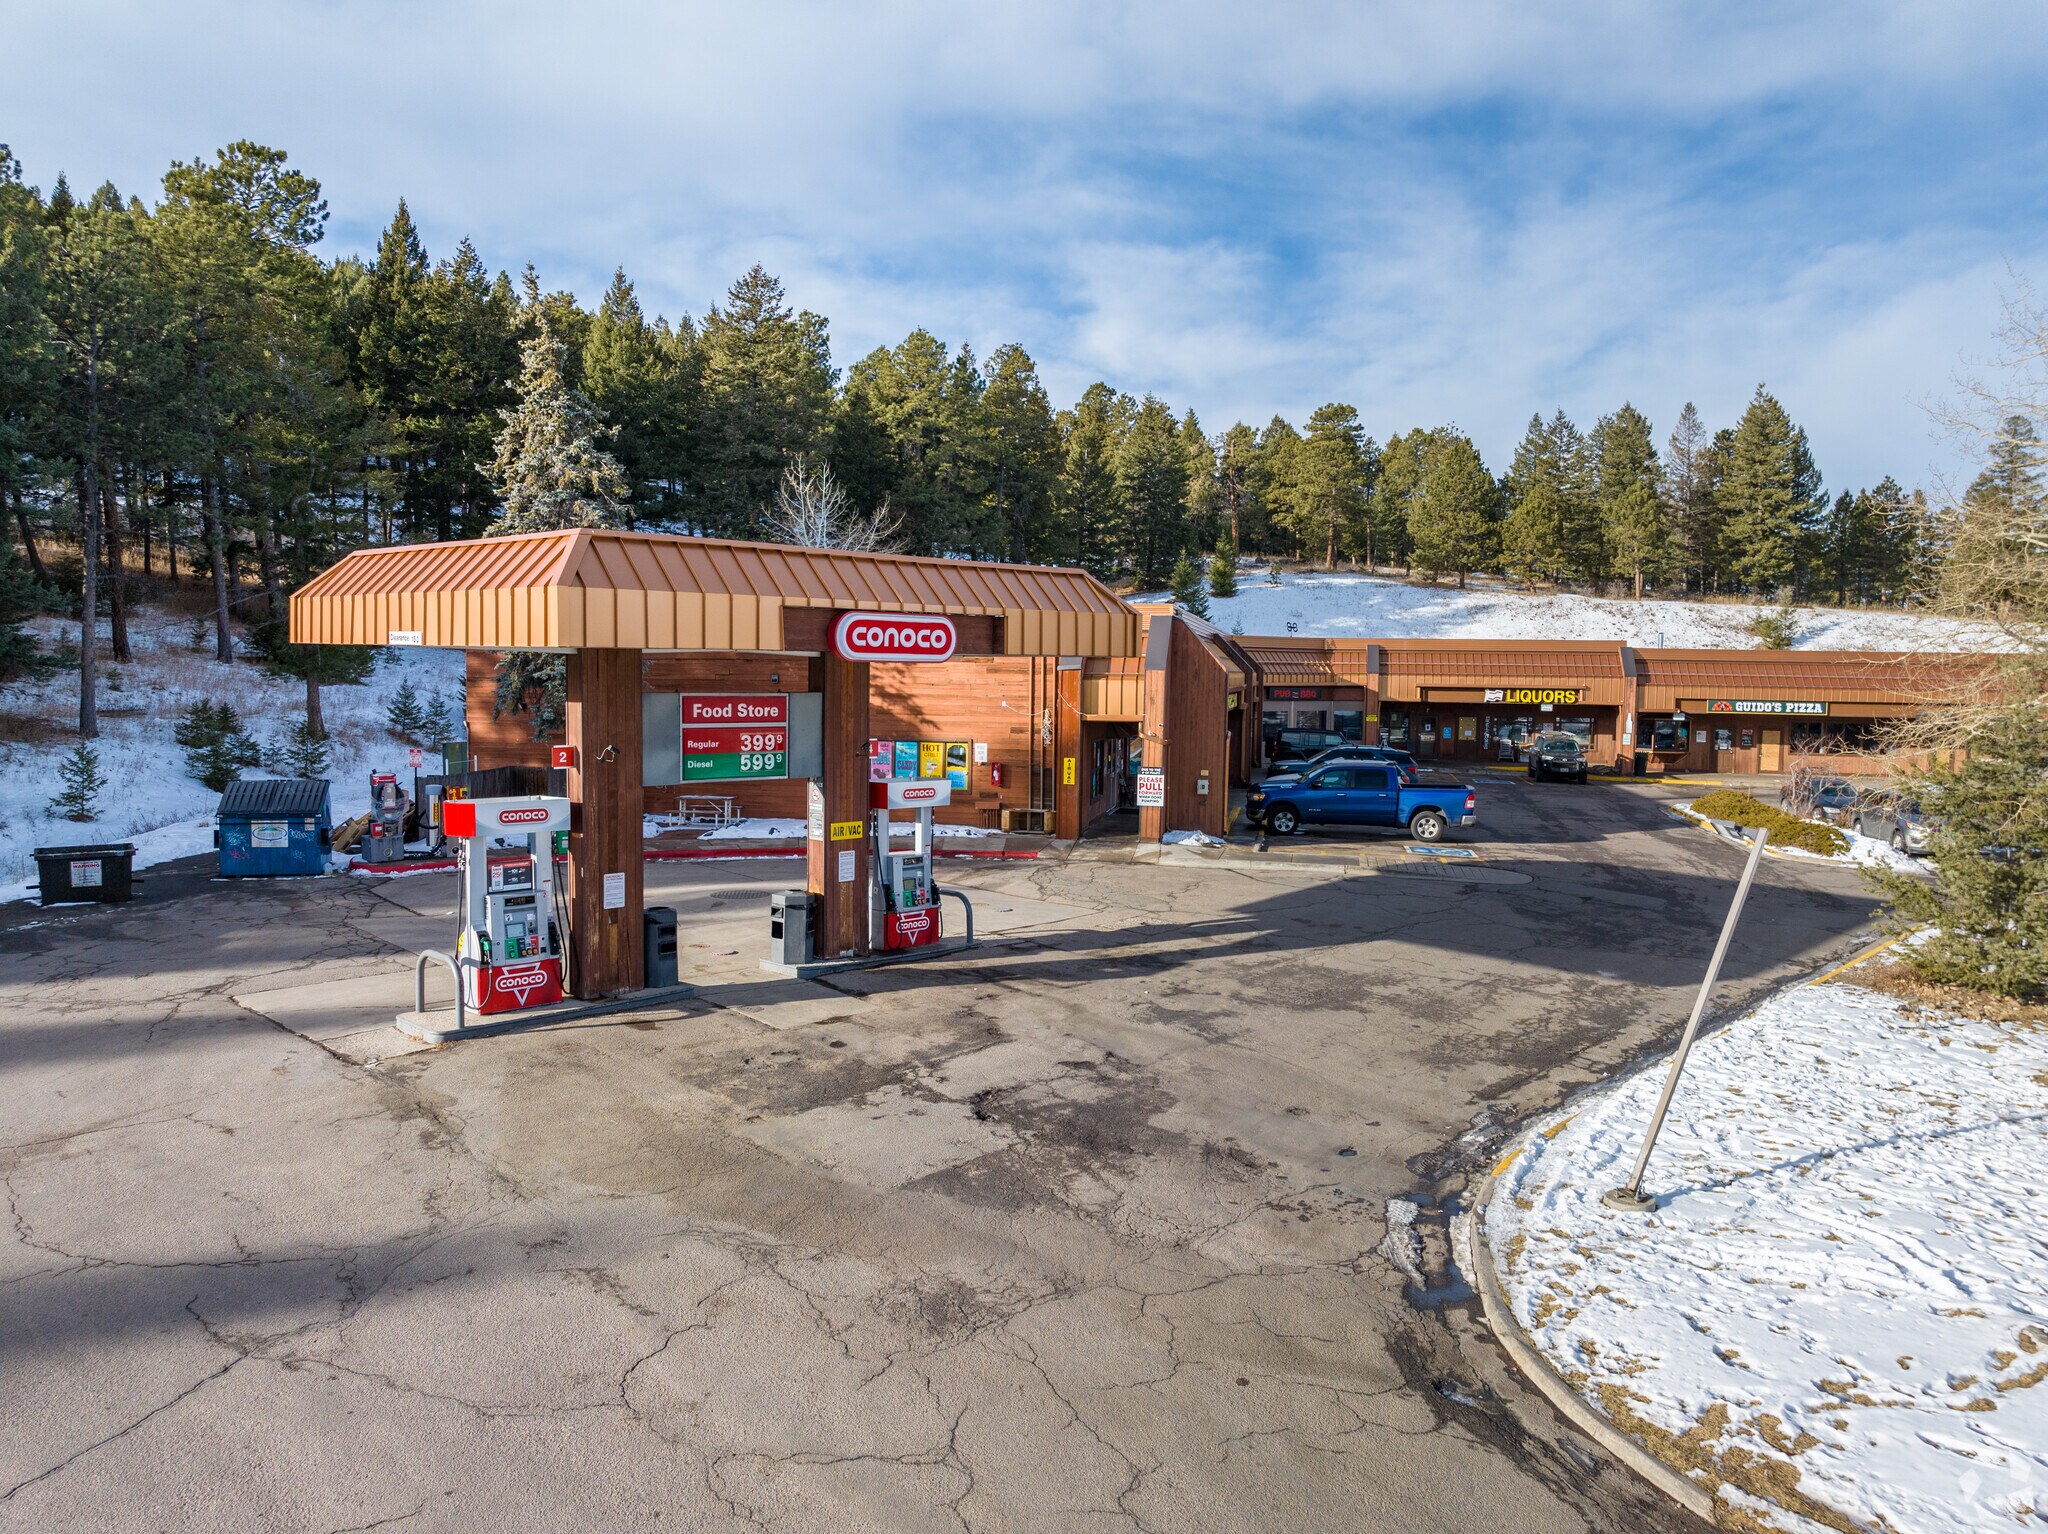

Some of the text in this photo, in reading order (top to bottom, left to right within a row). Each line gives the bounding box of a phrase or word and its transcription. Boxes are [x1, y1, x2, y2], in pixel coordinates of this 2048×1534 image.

[1273, 689, 1291, 697] PUB
[1506, 689, 1576, 703] LIQUORS
[693, 703, 779, 718] Food Store
[1735, 701, 1823, 713] GUIDO'S PIZZA
[687, 740, 720, 750] Regular
[922, 744, 941, 752] HOT
[559, 751, 567, 763] 2
[687, 760, 713, 769] Diesel
[1139, 783, 1163, 791] PULL
